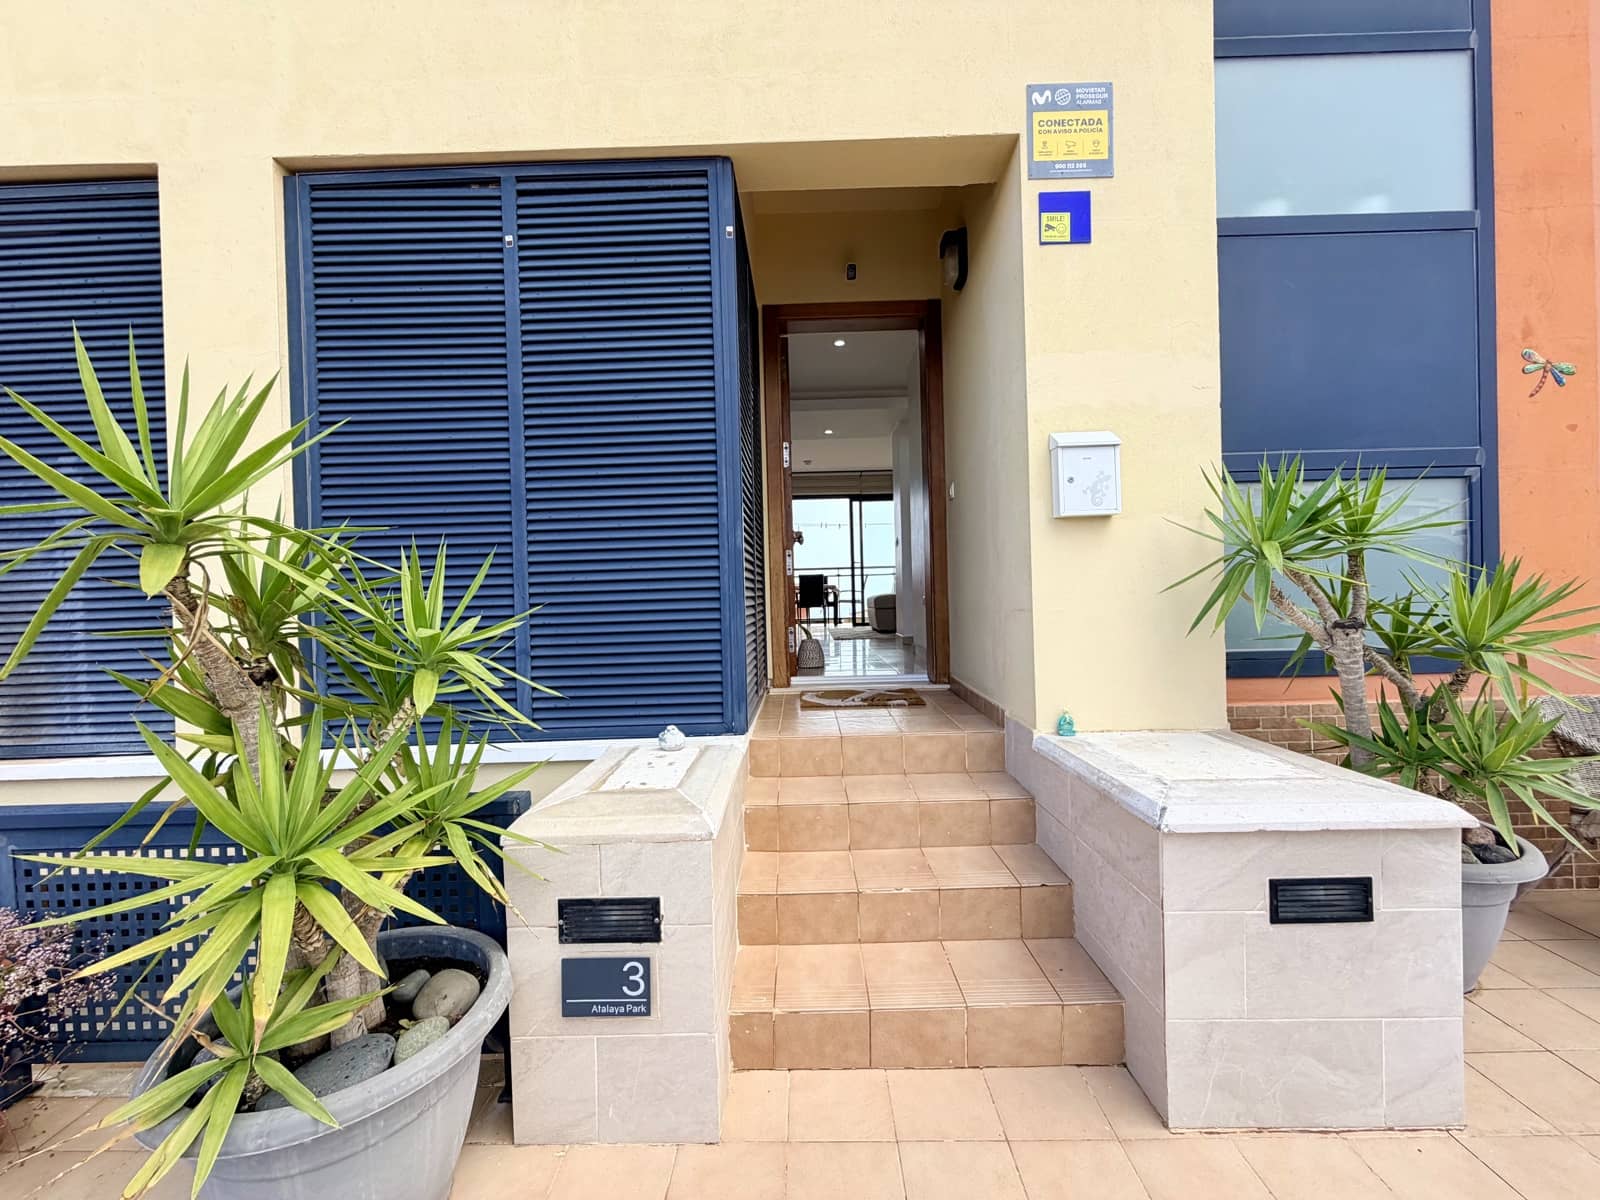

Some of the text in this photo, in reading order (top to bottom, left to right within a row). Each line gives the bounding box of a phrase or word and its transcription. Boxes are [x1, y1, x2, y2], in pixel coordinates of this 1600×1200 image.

[1038, 118, 1103, 127] CONECTADA
[622, 961, 645, 996] 3
[591, 1004, 647, 1015] Atalaya Park
